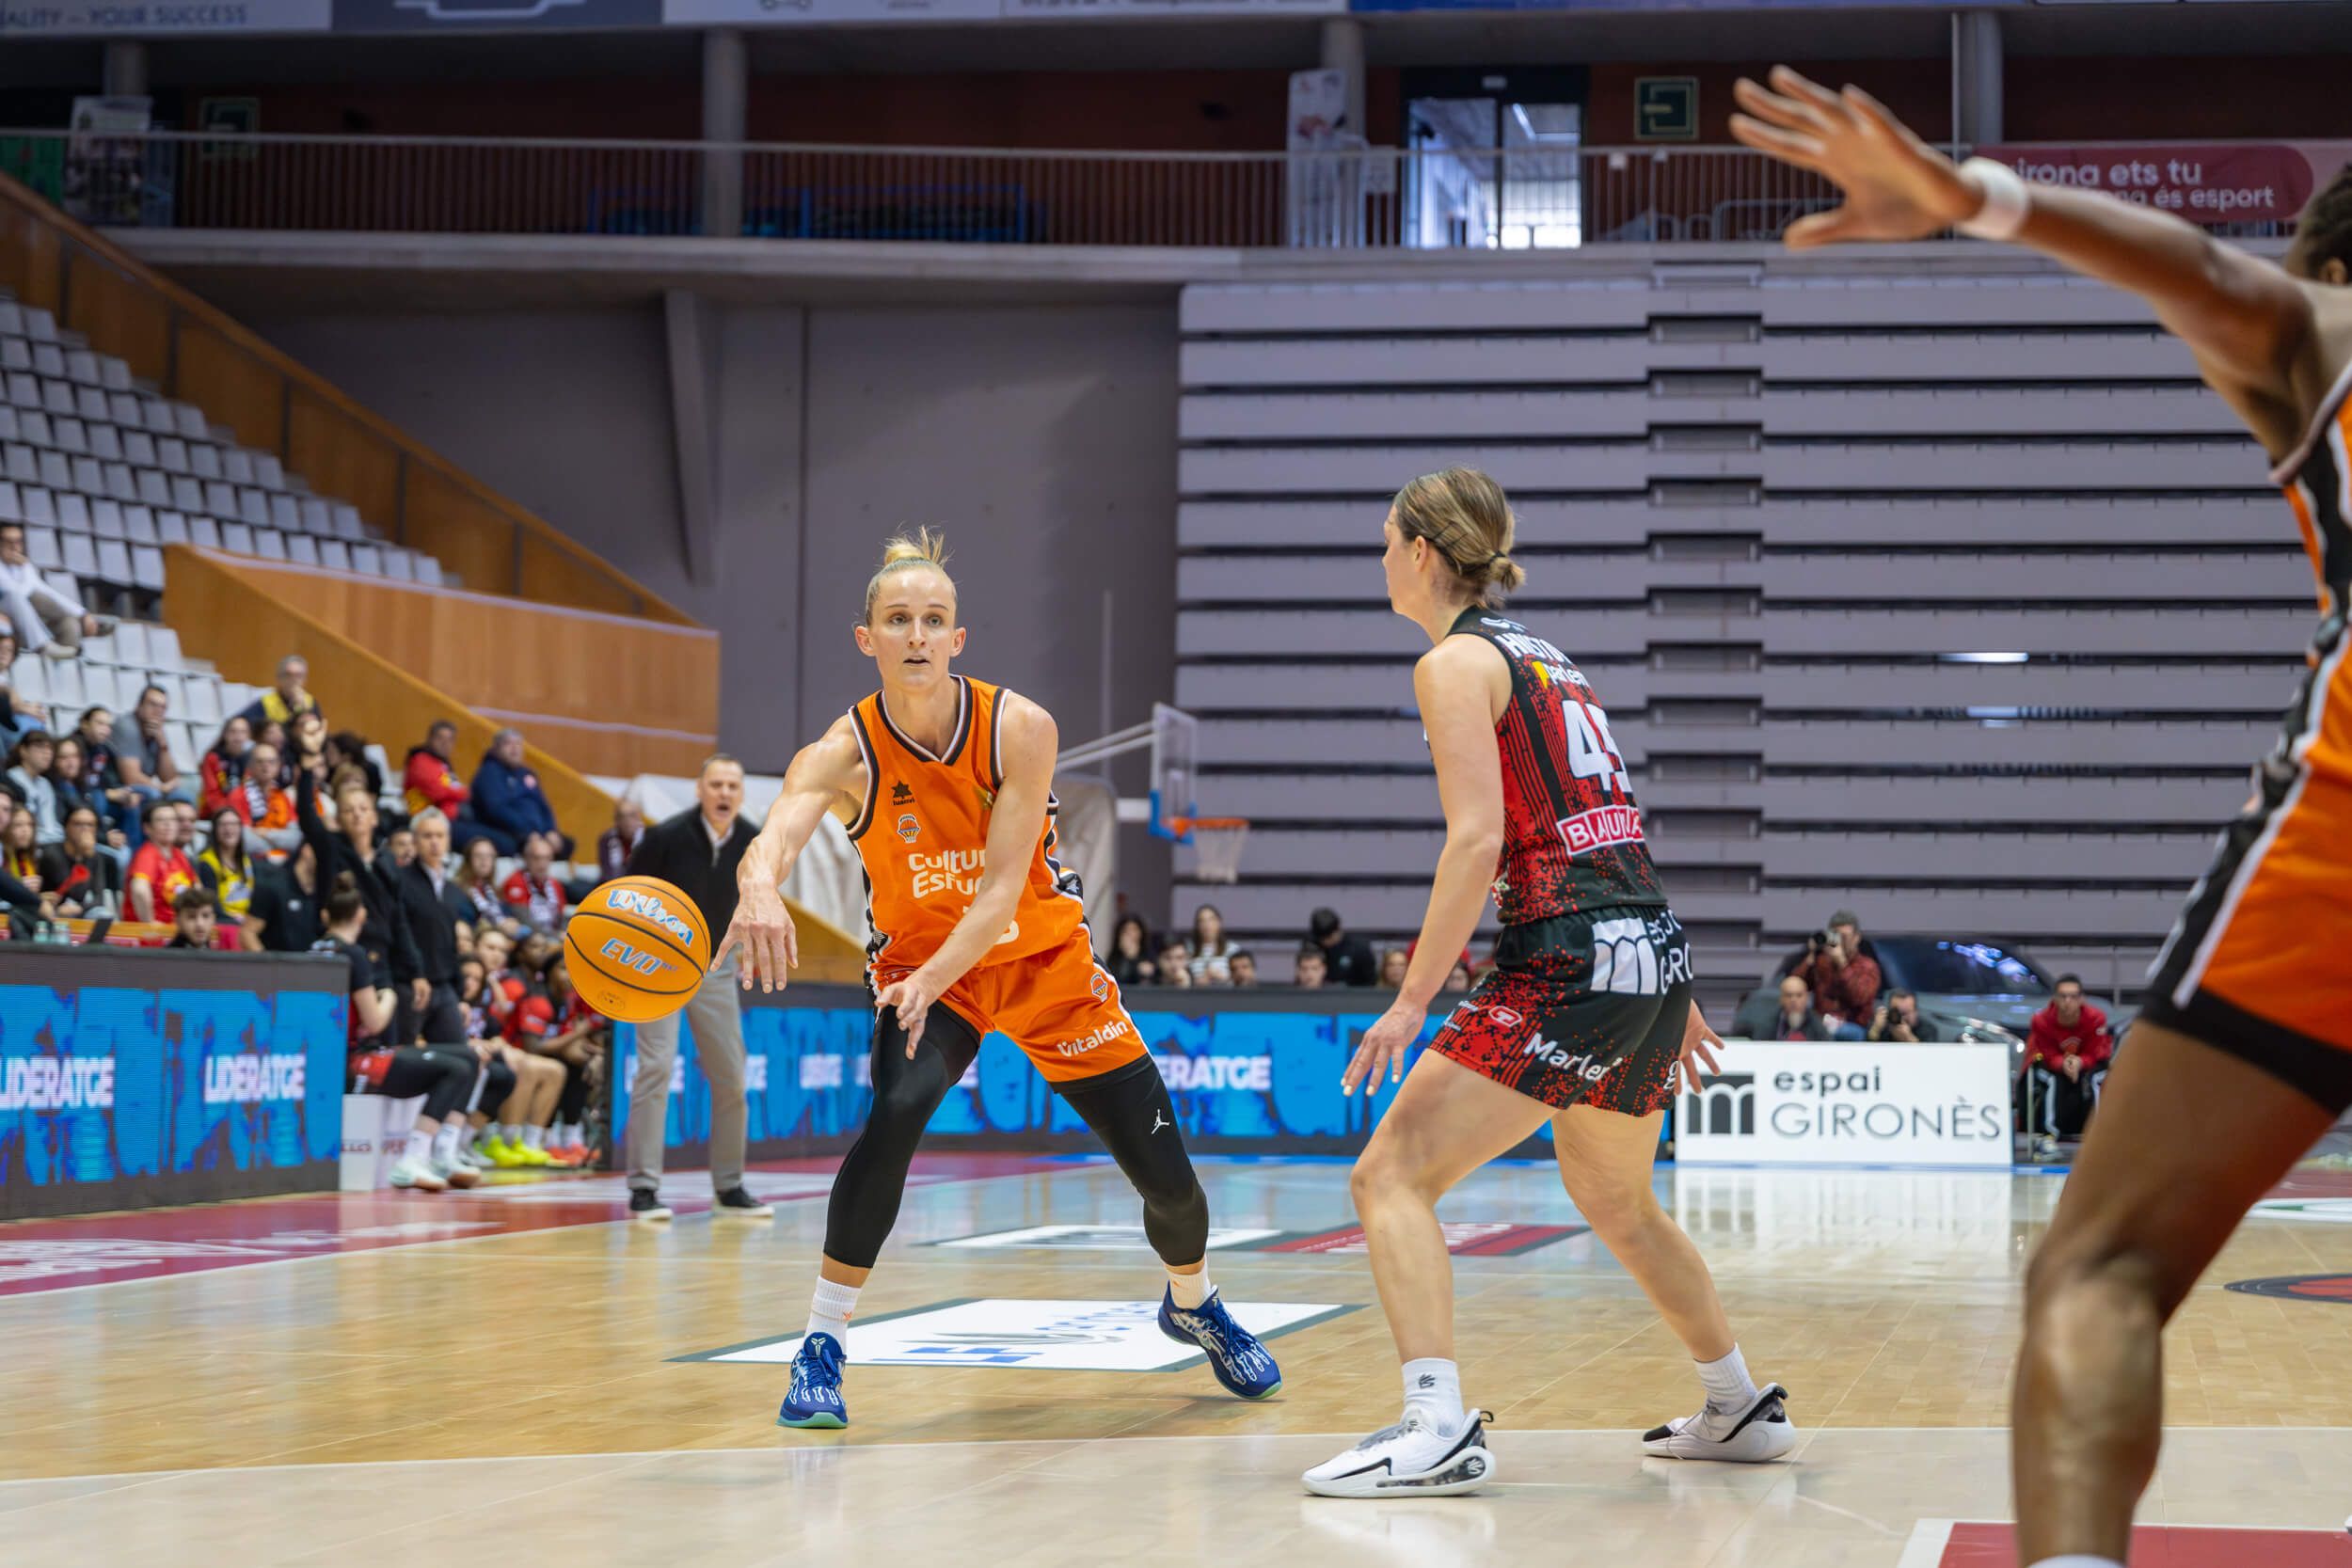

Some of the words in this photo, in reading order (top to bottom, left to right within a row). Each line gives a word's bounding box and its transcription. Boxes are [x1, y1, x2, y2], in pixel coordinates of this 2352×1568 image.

[154, 5, 247, 24] SUCCESS
[2013, 157, 2100, 186] irona
[2108, 158, 2159, 186] ets
[2168, 158, 2202, 186] tu
[2154, 184, 2184, 209] és
[2189, 185, 2275, 214] esport
[607, 889, 694, 948] Wilson
[601, 938, 663, 976] EVO
[1057, 1019, 1129, 1058] Vitaldin
[204, 1053, 307, 1104] LIDERATGE
[1773, 1066, 1883, 1098] espai
[1771, 1095, 2001, 1139] GIRONÈS
